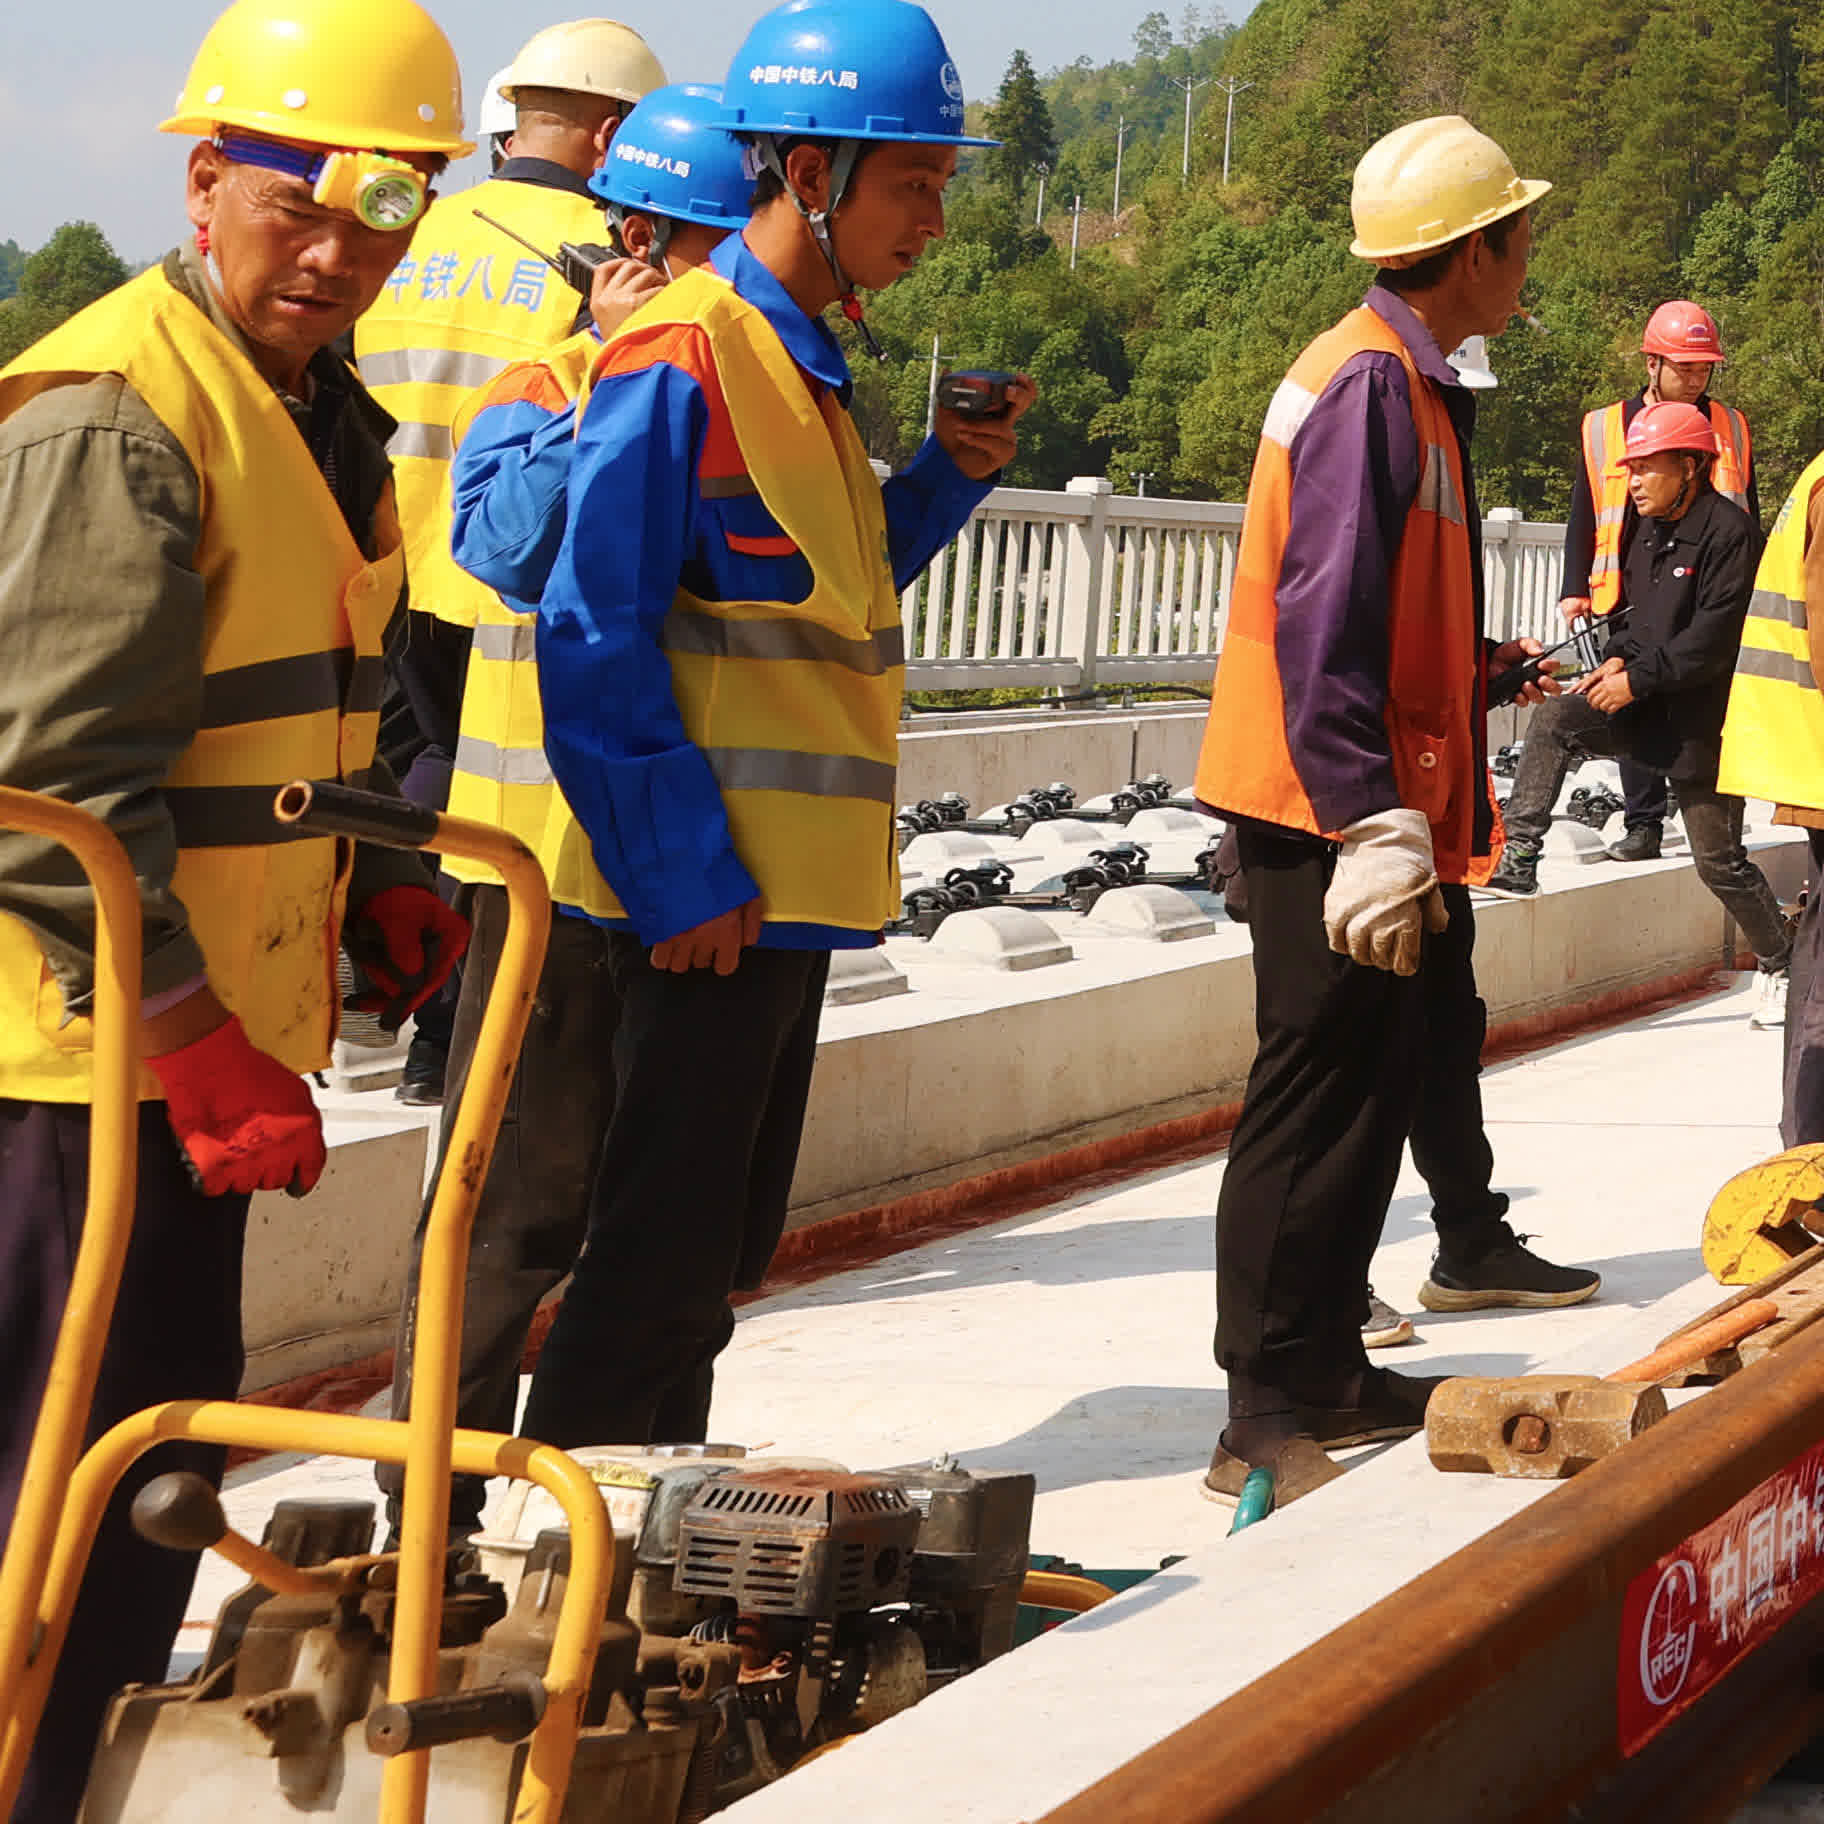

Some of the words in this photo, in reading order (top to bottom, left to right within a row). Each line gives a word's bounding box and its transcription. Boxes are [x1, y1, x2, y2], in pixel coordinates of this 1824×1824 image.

[750, 65, 860, 90] 中国中铁八局
[616, 143, 691, 178] 中国中铁八局
